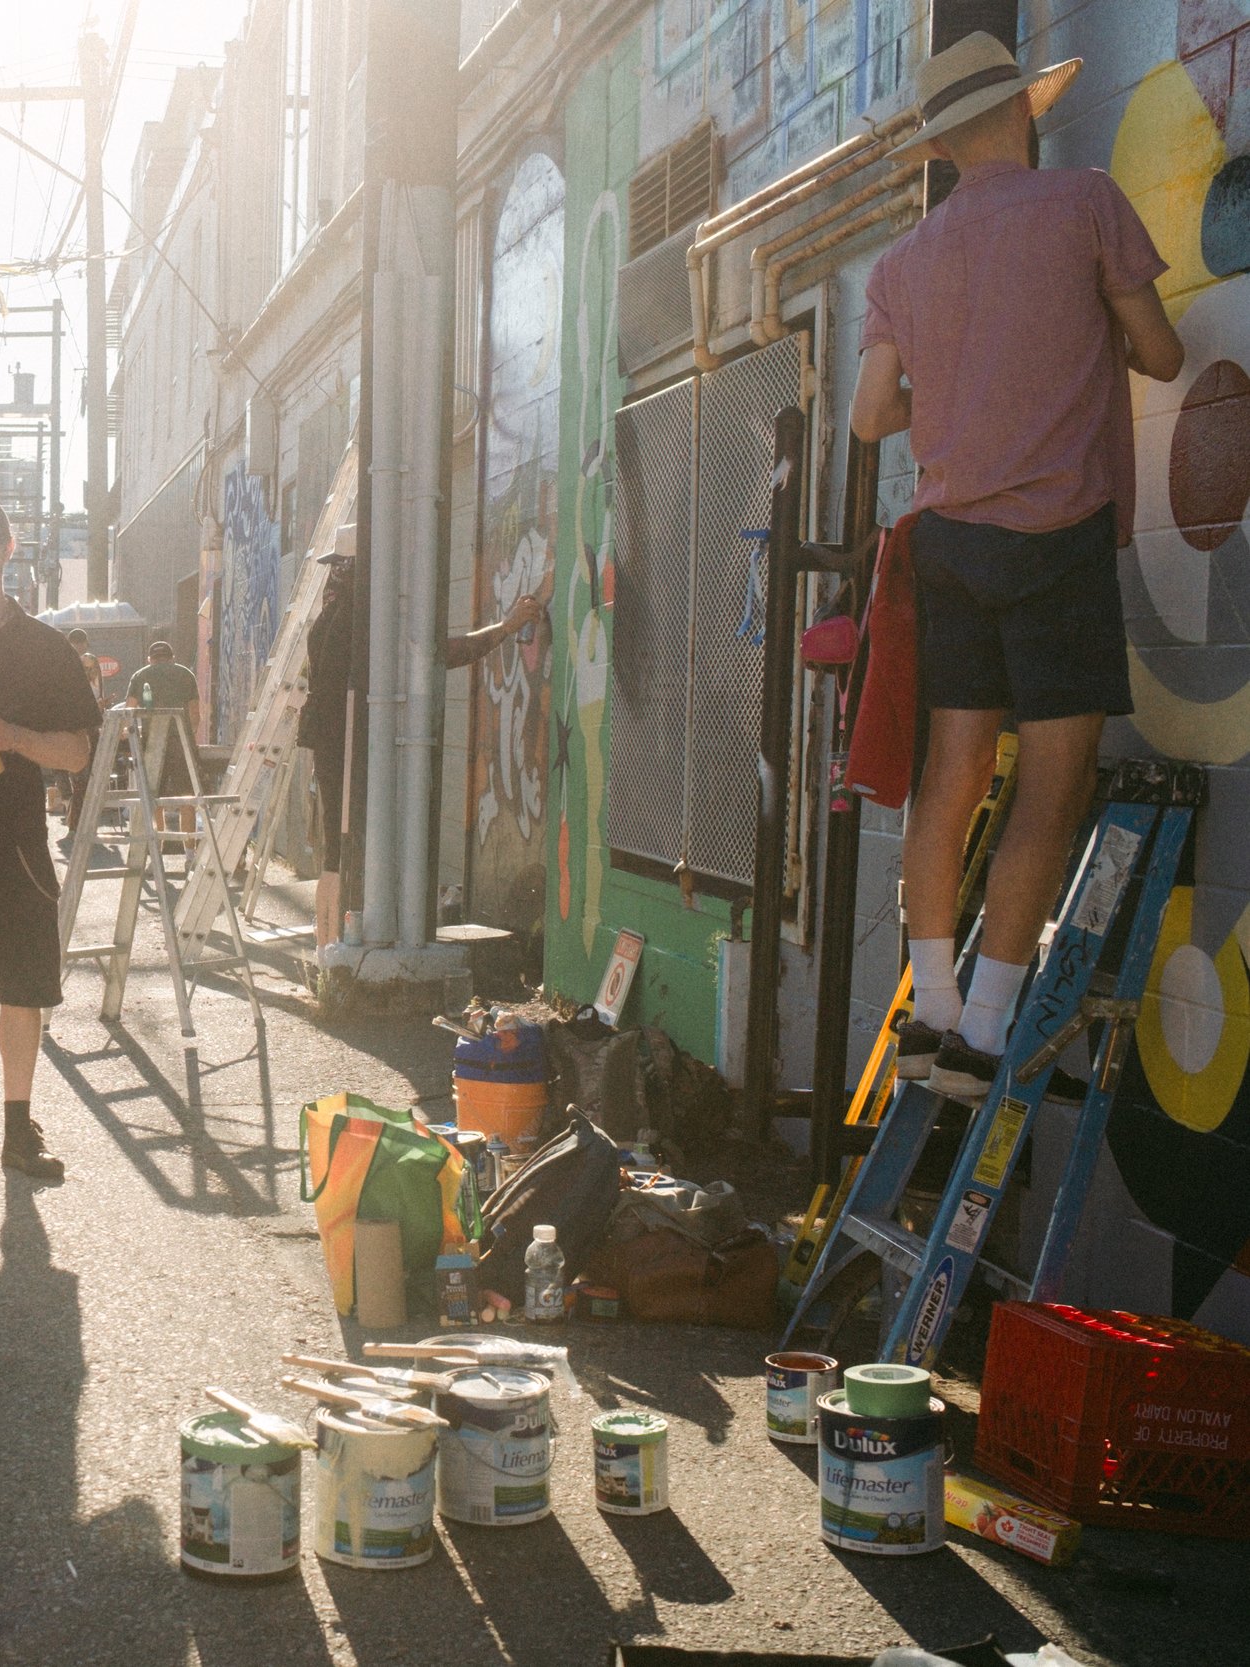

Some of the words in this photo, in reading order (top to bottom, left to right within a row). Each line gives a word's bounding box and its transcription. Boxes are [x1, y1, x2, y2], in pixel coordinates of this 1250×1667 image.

[913, 1280, 946, 1353] WERNER
[1134, 1403, 1170, 1421] DAIRY
[1176, 1408, 1231, 1427] AVALON
[834, 1429, 897, 1456] Dulux
[1133, 1426, 1150, 1441] OF
[1158, 1428, 1228, 1450] PROPERTY
[826, 1466, 911, 1494] Lifemaster
